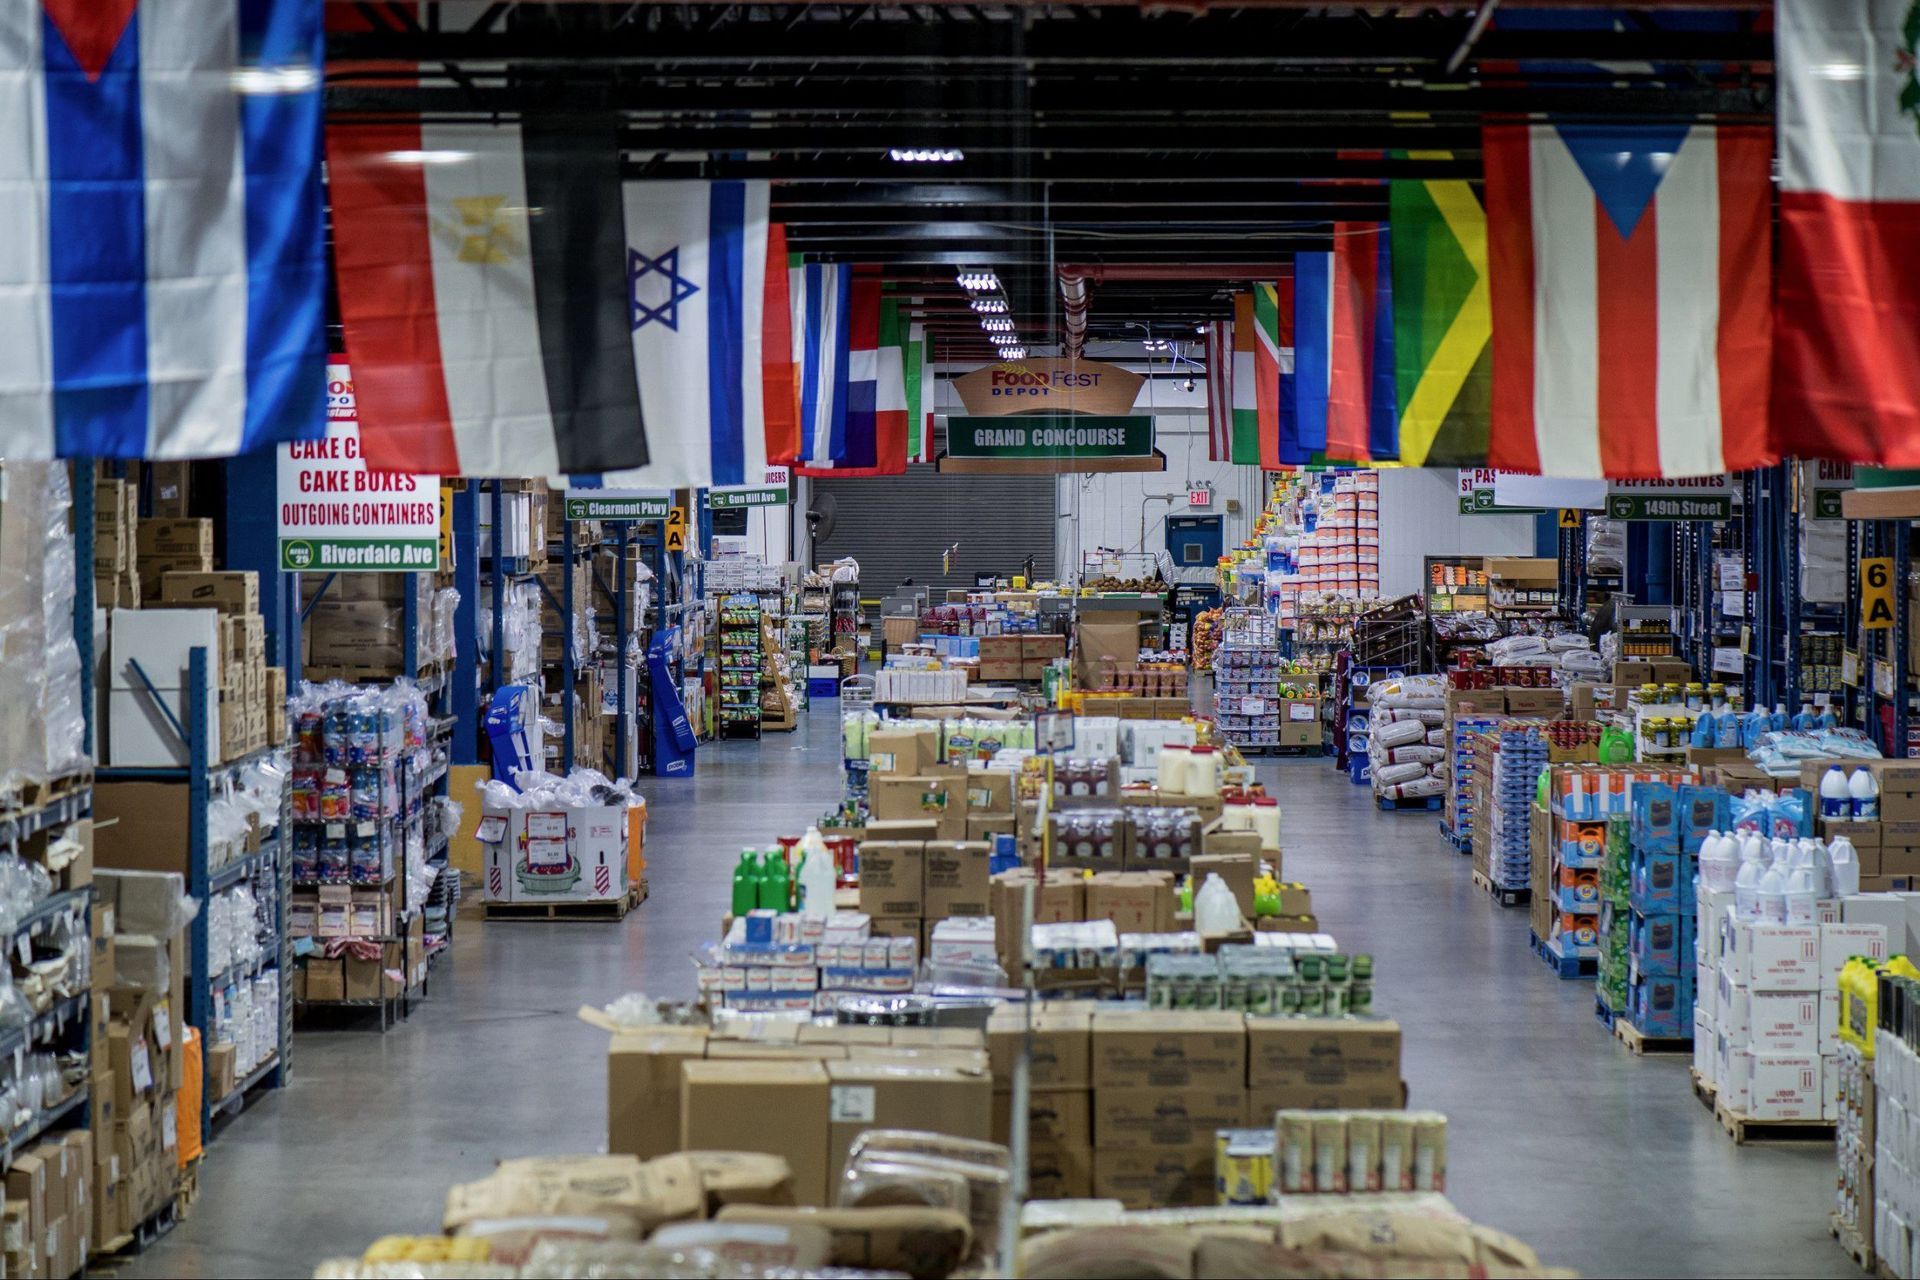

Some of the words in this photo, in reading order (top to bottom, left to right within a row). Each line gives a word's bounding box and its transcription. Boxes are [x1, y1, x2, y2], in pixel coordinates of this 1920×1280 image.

[992, 371, 1049, 386] FOOD
[992, 388, 1049, 396] DEPOT
[974, 429, 1026, 447] GRAND
[1032, 428, 1126, 447] CONCOURSE
[290, 437, 339, 460] CAKE
[300, 470, 349, 493] CAKE
[354, 470, 416, 492] BOXES
[728, 494, 745, 504] Gun
[746, 493, 760, 503] Hill
[761, 492, 776, 502] Ave
[1191, 491, 1208, 504] EXIT
[283, 503, 349, 526] OUTGOING
[353, 503, 434, 526] CONTAINERS
[589, 502, 641, 515] Clearmont
[641, 502, 667, 515] Pkwy
[1644, 500, 1680, 515] 149th
[1682, 500, 1722, 515] Street
[669, 510, 681, 525] 2
[1562, 508, 1577, 523] A
[668, 531, 682, 546] A
[321, 544, 401, 564] Riverdale
[402, 544, 433, 564] Ave
[1868, 564, 1887, 588] 6
[1868, 598, 1894, 622] A
